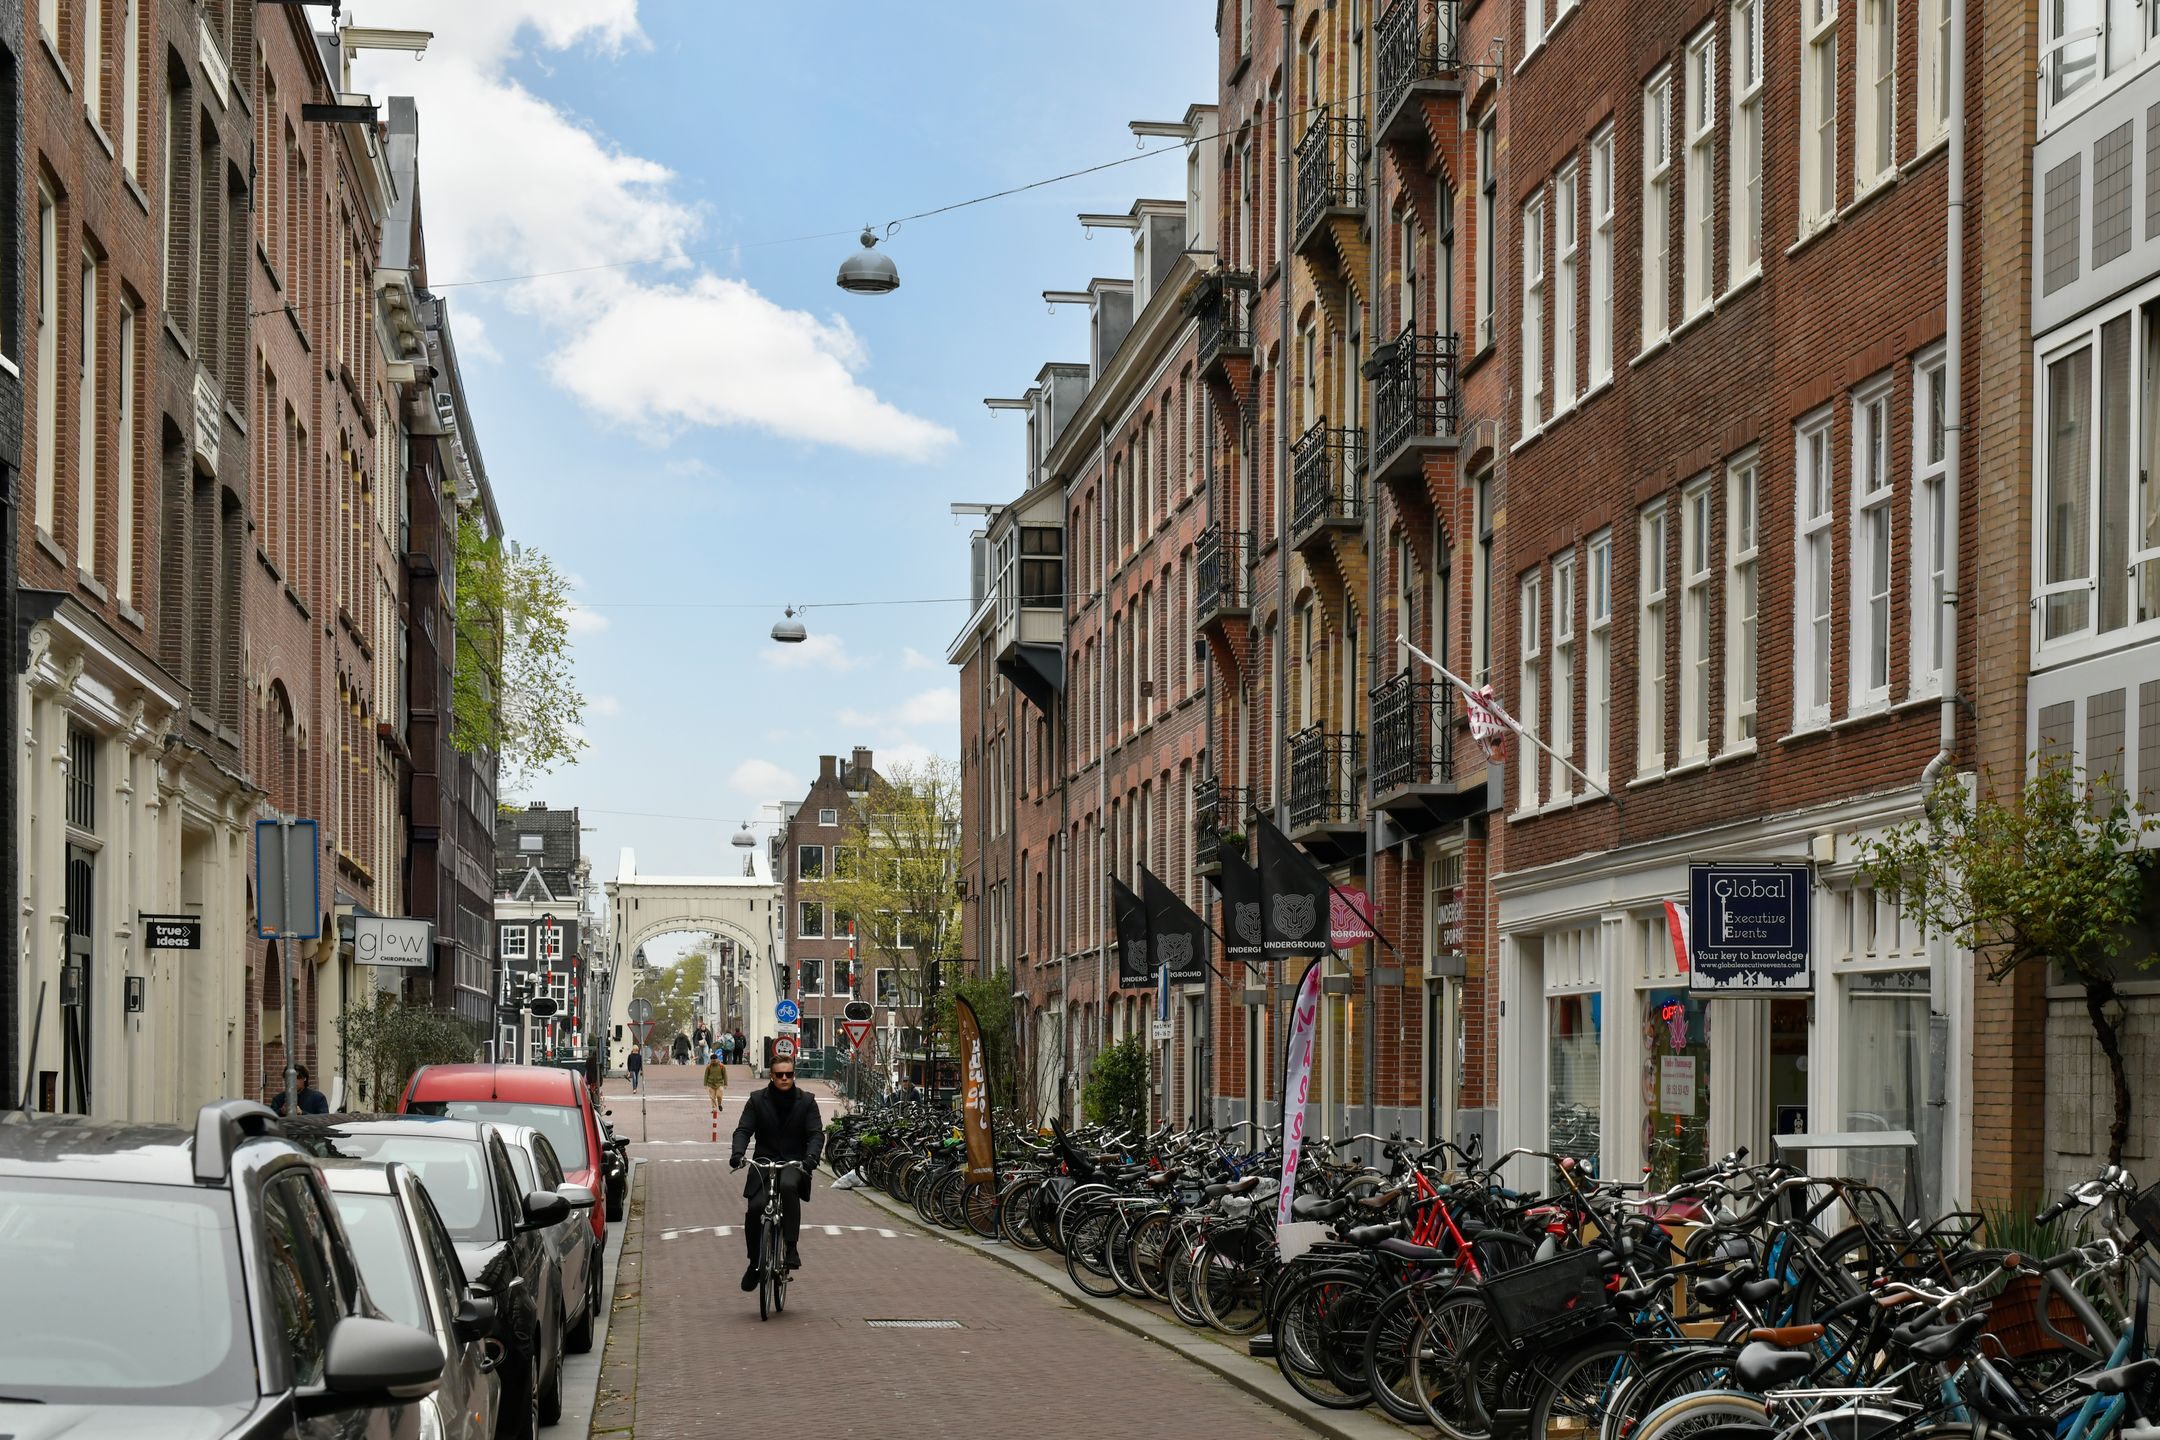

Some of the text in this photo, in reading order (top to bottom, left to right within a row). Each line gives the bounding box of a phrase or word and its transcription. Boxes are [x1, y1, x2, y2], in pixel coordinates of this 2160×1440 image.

[1715, 879, 1786, 898] Global
[1725, 911, 1786, 924] Executive
[156, 925, 182, 935] true
[1725, 926, 1768, 938] Events
[156, 936, 190, 947] ideas
[359, 922, 424, 961] glow
[1263, 941, 1326, 949] UNDERGROUND
[380, 955, 424, 964] CHIROPRACTIC
[1697, 950, 1804, 962] Your key to knowledge
[1277, 1004, 1316, 1226] MASSA
